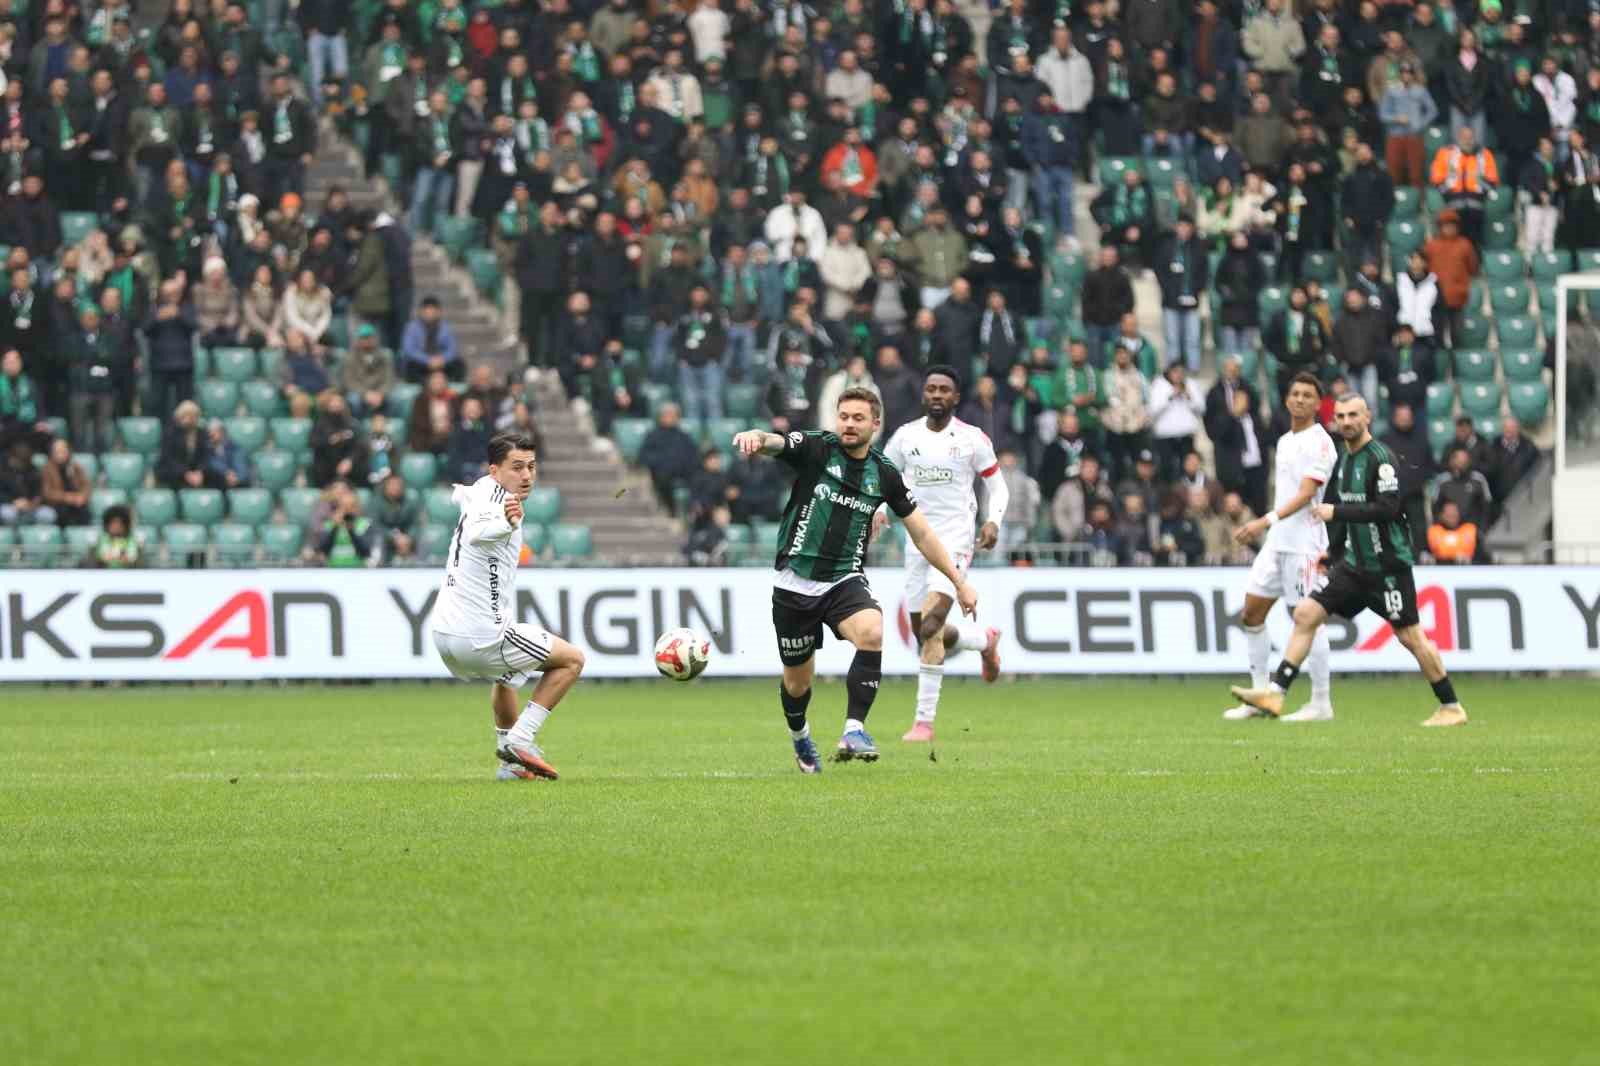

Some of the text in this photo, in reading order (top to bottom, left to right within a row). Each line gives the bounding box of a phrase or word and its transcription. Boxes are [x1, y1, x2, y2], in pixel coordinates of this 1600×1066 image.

[914, 465, 952, 482] beko
[829, 492, 875, 515] SAFİPOR
[852, 536, 865, 571] TUKA
[1384, 590, 1404, 613] 19
[0, 588, 734, 658] KSAN YNGIN
